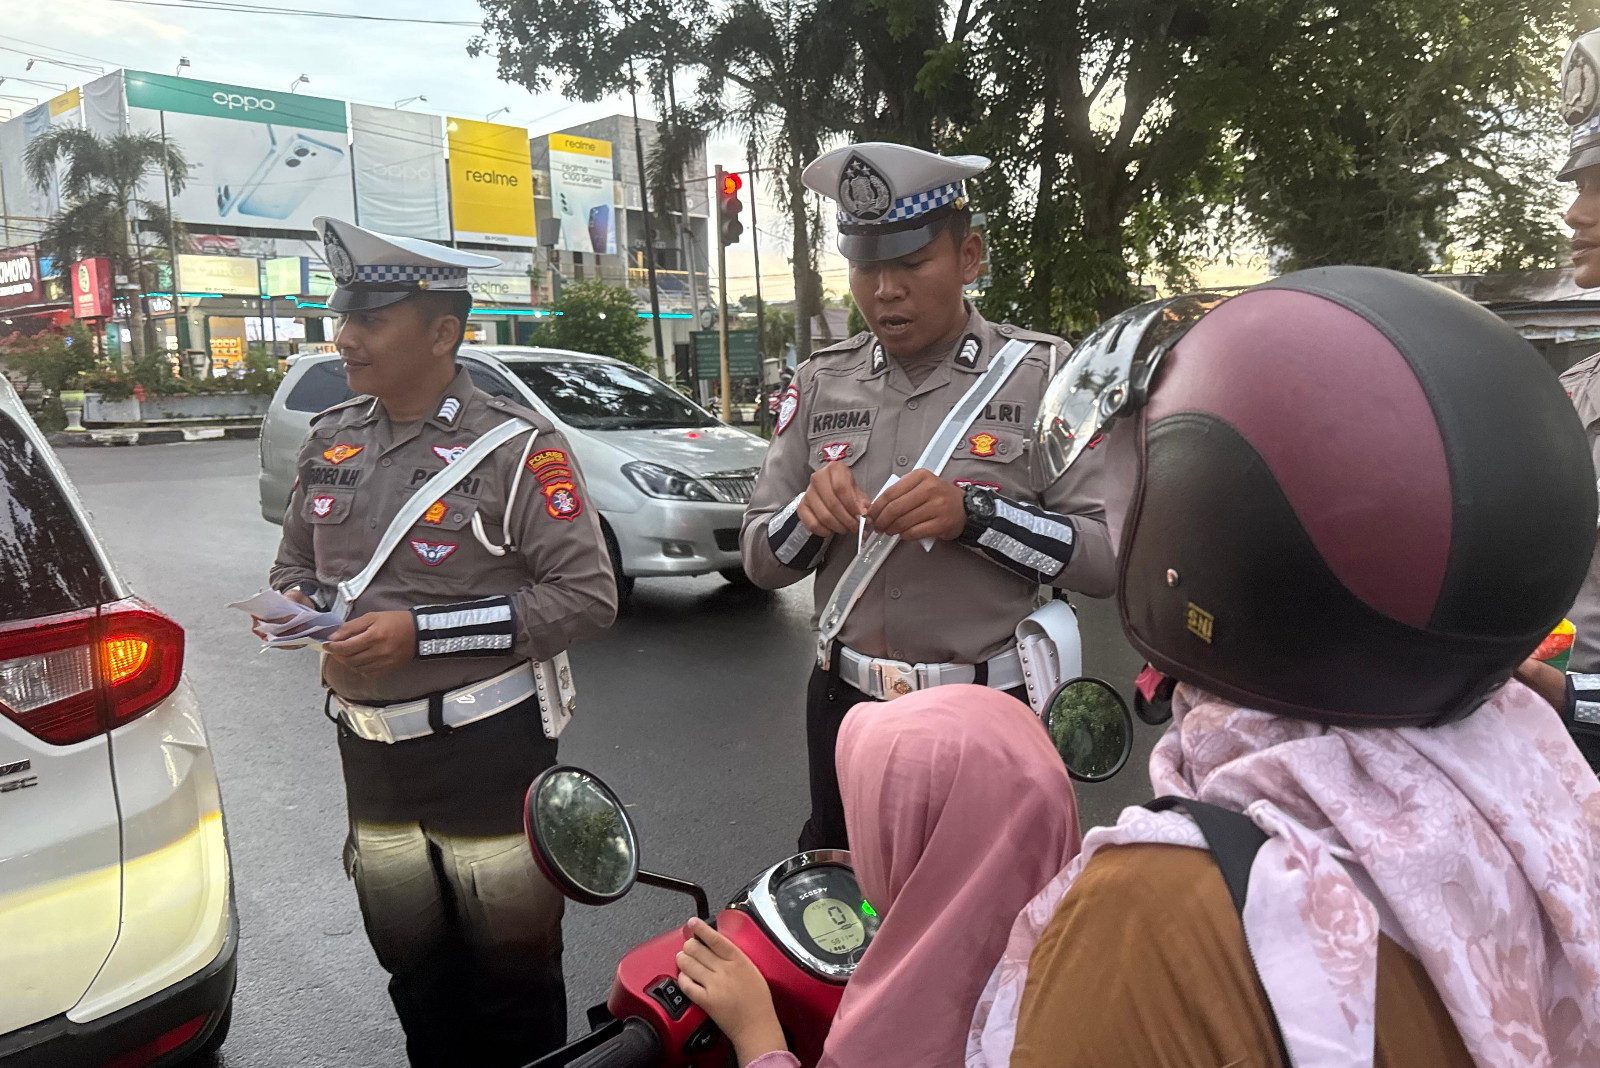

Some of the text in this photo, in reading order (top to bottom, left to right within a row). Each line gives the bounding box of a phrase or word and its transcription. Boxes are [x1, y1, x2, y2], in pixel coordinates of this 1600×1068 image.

[212, 92, 276, 111] oppo
[565, 140, 596, 151] realme
[466, 170, 518, 187] realme
[827, 906, 847, 925] 0
